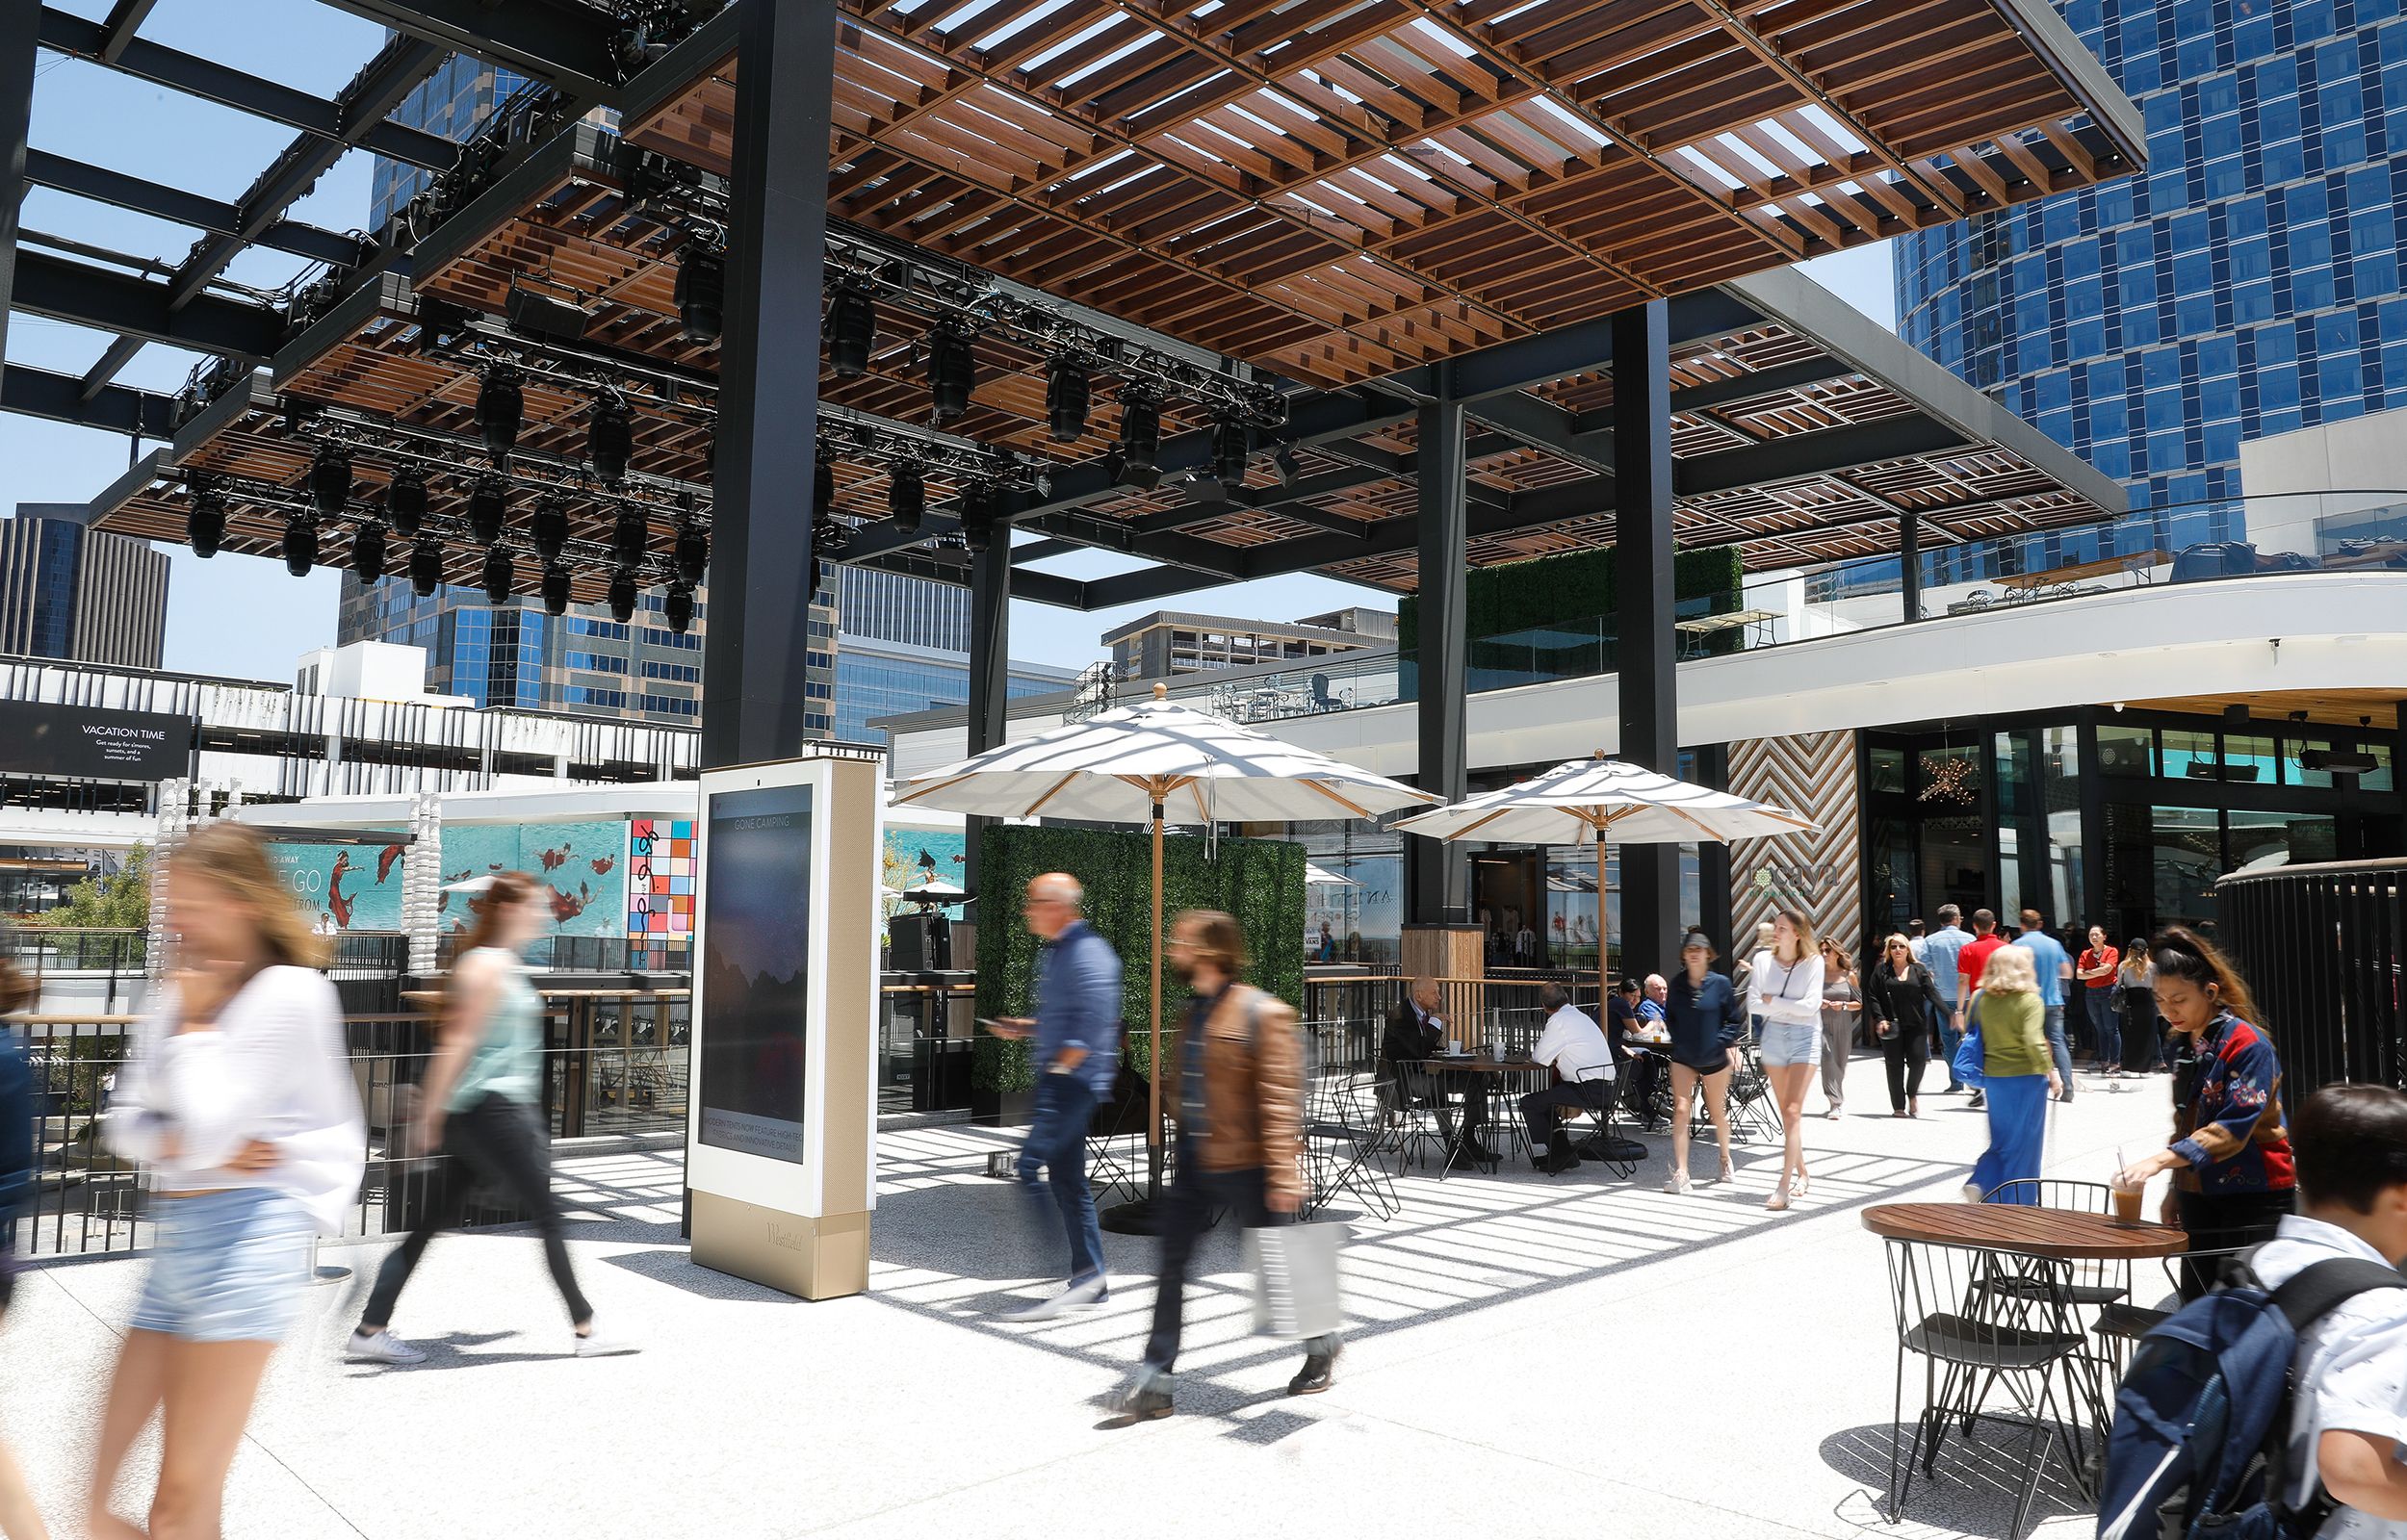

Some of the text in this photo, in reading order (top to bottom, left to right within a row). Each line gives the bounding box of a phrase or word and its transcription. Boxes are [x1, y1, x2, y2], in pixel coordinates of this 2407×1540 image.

[82, 725, 166, 740] VACATION TIME
[734, 815, 789, 831] GONE CAMPING
[279, 856, 300, 864] AWAY
[293, 869, 322, 892] GO
[726, 1119, 740, 1131] TENTS
[740, 1123, 754, 1133] NOW
[755, 1124, 777, 1138] FEATURE
[778, 1130, 802, 1142] HIGH-TEC
[733, 1134, 743, 1142] AND
[766, 1221, 803, 1252] Westfield
